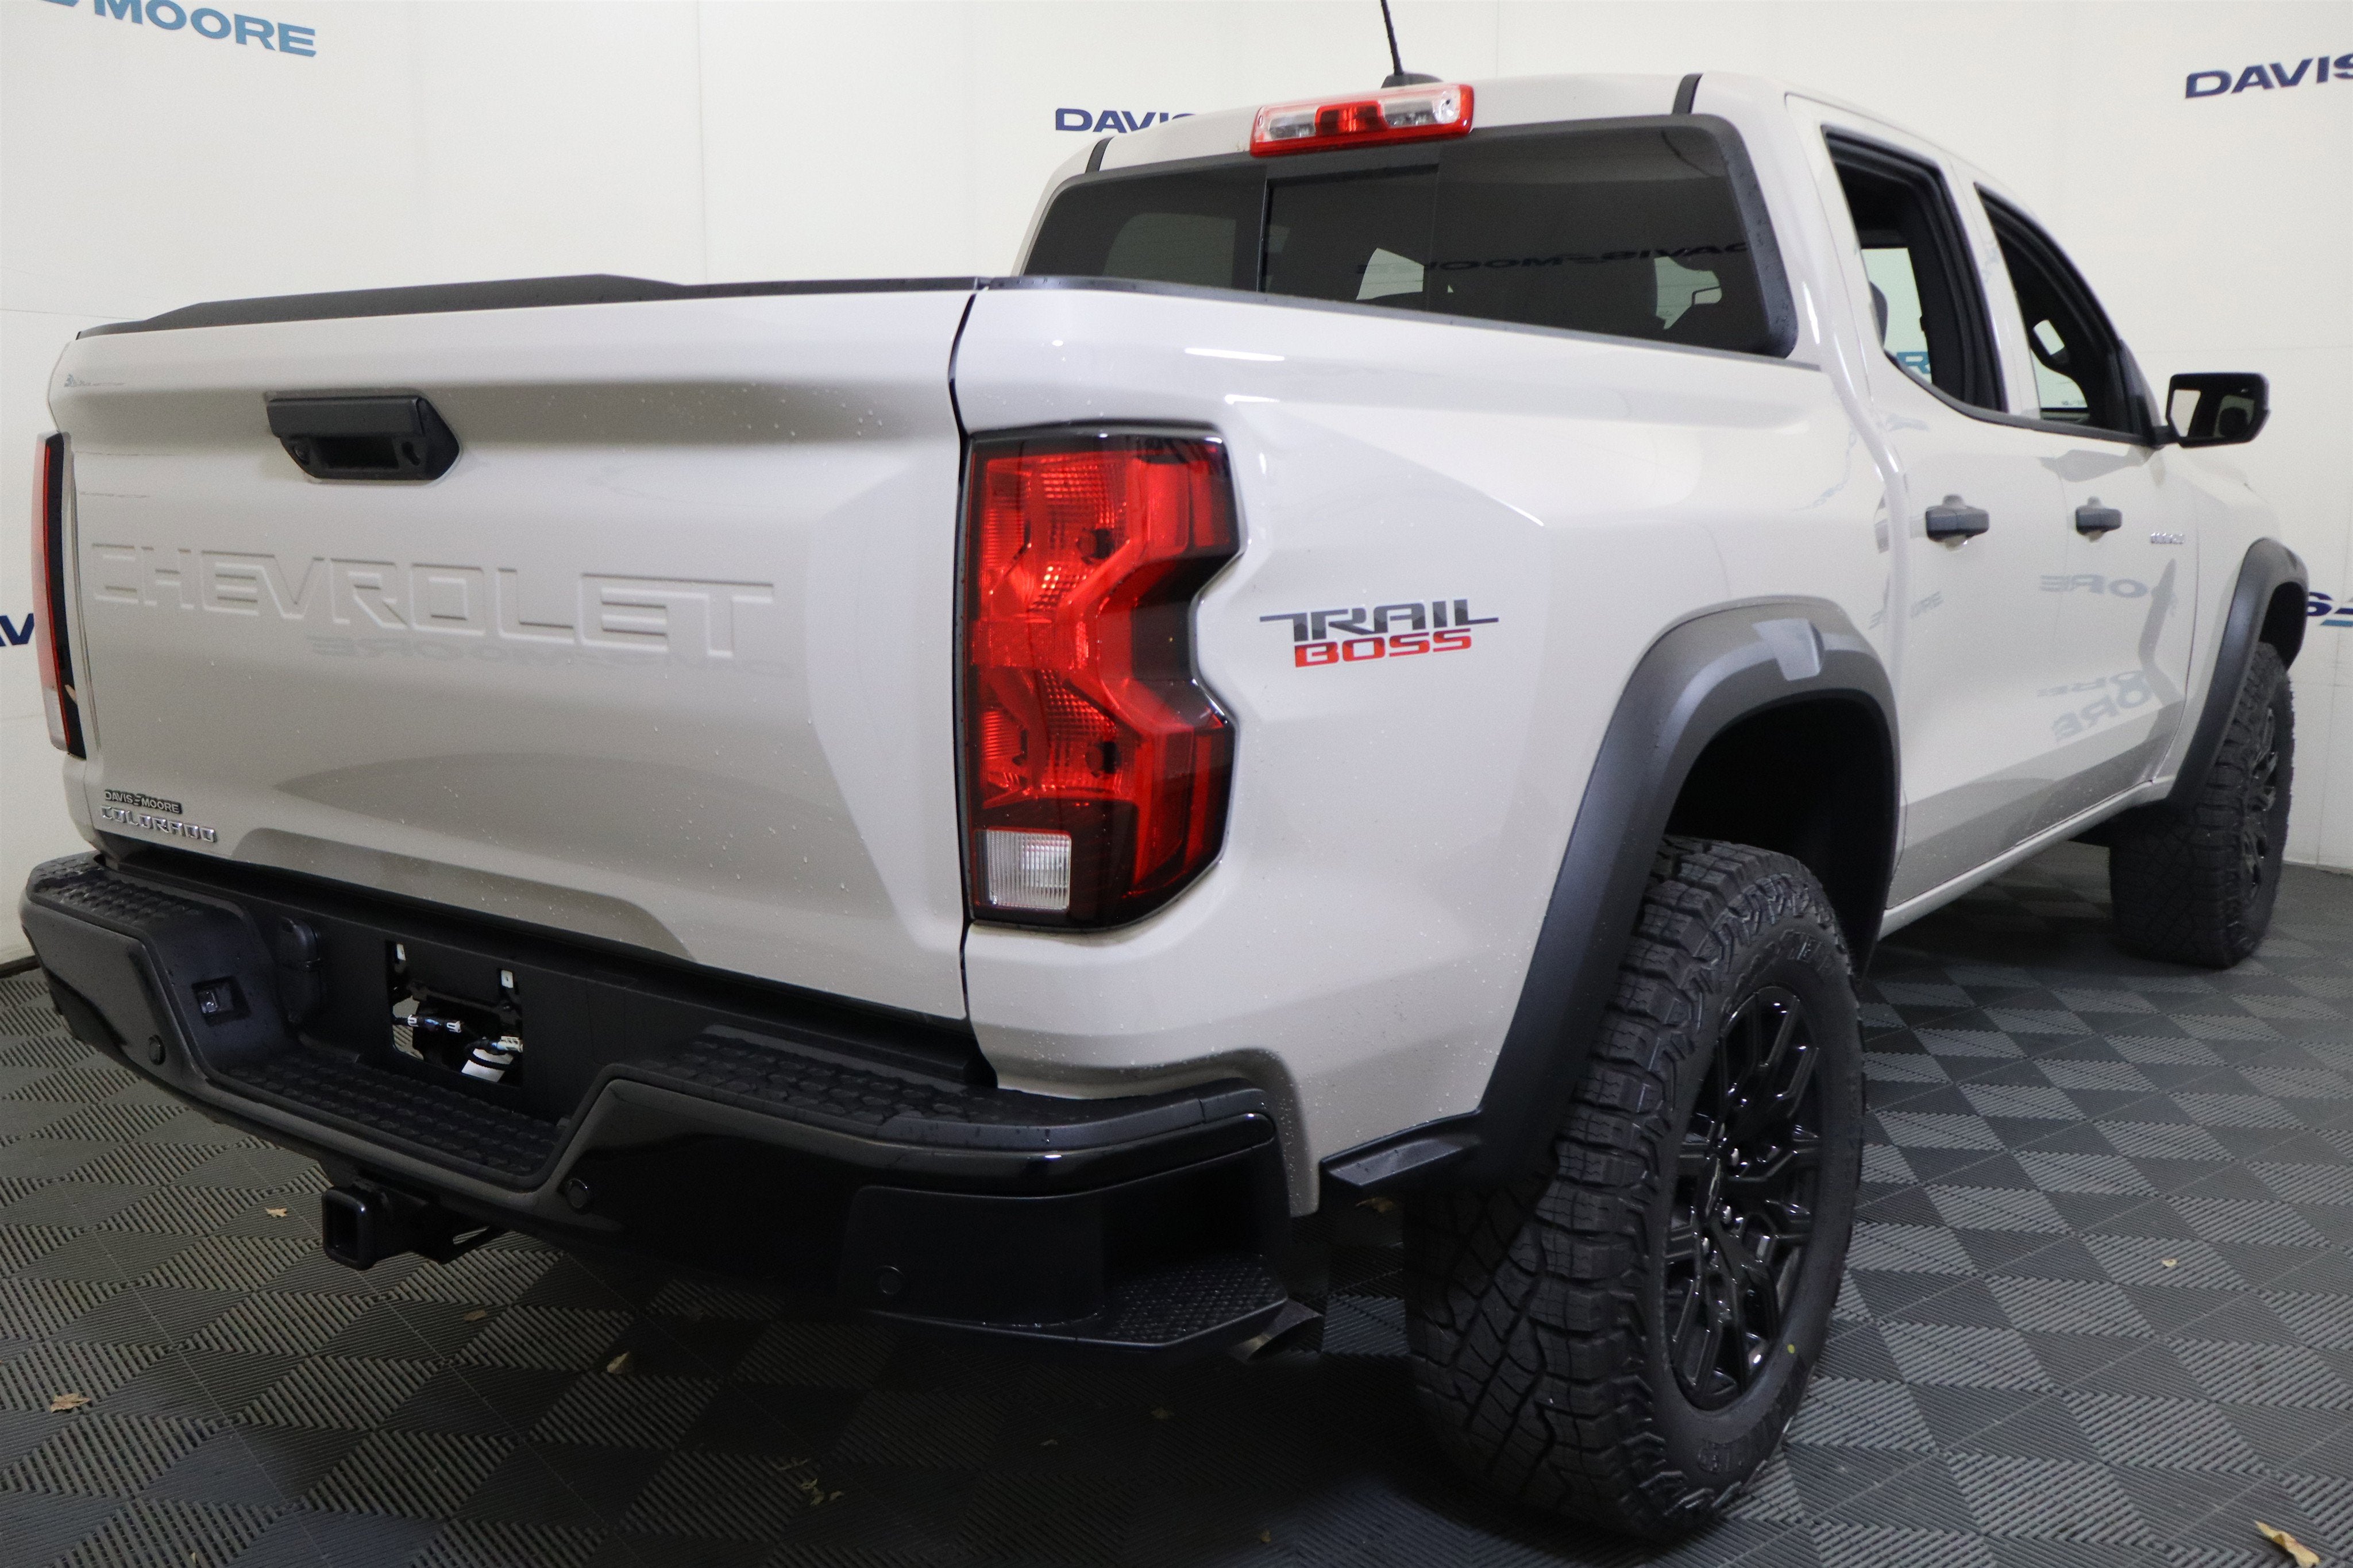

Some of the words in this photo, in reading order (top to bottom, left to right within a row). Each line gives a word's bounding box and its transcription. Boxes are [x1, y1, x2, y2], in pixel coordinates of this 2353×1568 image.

[1056, 107, 1196, 133] DAV
[92, 542, 774, 658] CHEVROLET
[1260, 599, 1499, 642] TRAIL
[1295, 628, 1471, 667] BOSS
[101, 805, 217, 843] COLORADO
